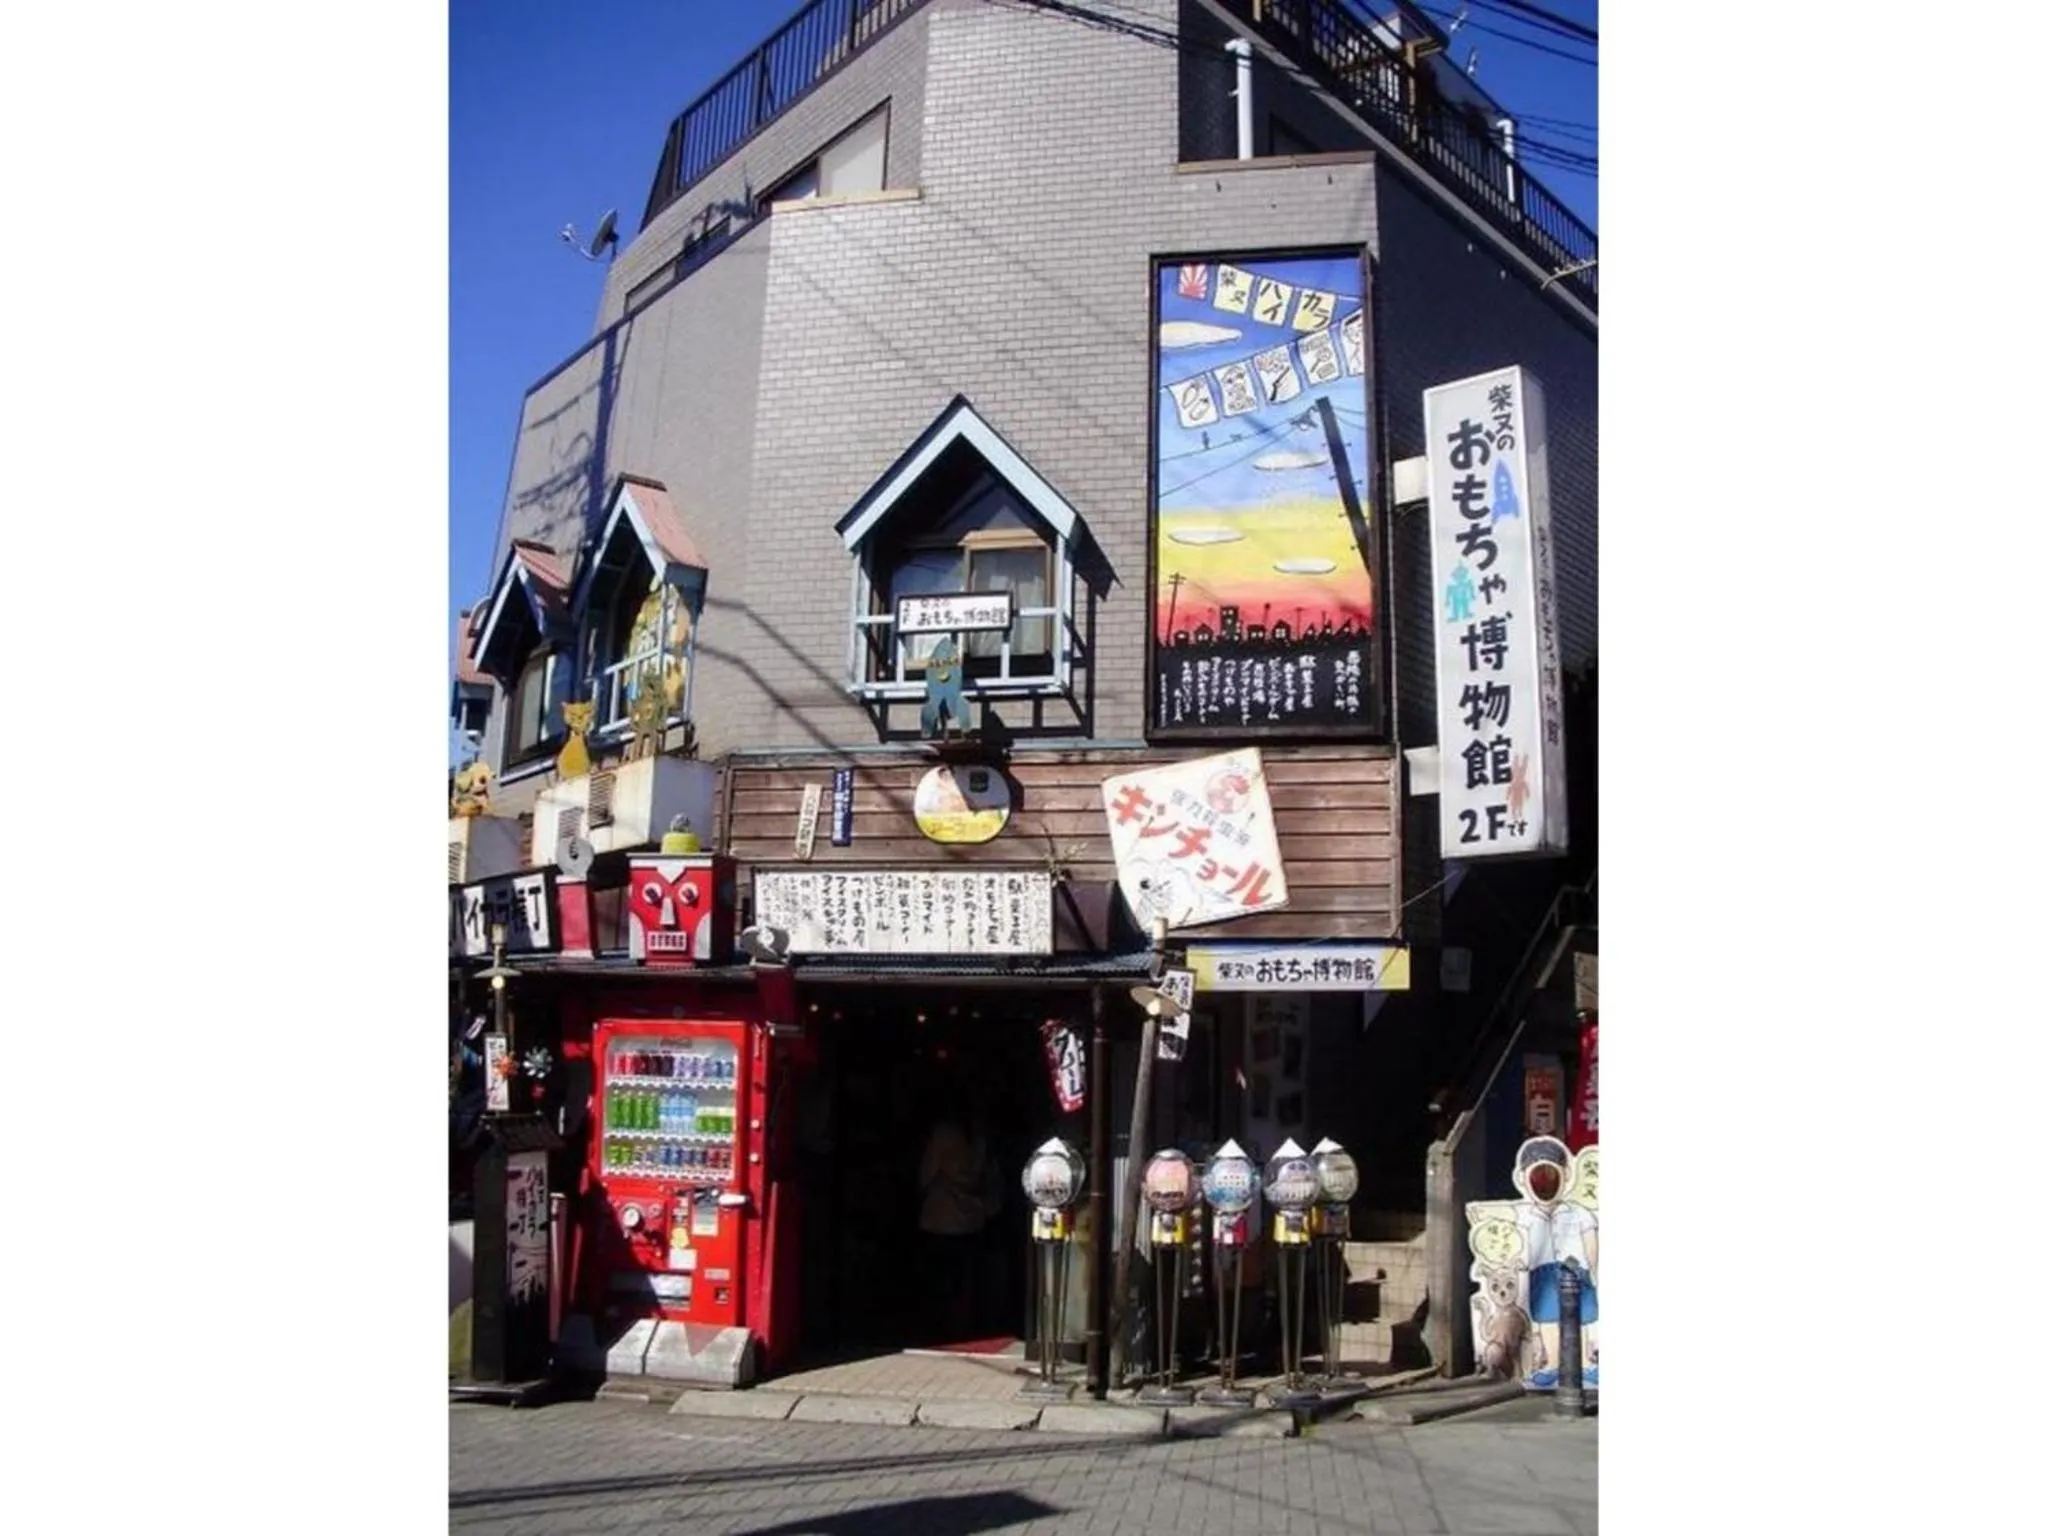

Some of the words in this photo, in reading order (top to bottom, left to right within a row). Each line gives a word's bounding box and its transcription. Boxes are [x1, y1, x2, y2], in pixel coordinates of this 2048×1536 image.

[1487, 384, 1516, 452] 柴又の
[1447, 418, 1512, 790] おもちゃ博物館
[1112, 783, 1273, 906] キンチョール
[1459, 804, 1529, 844] 2Fです
